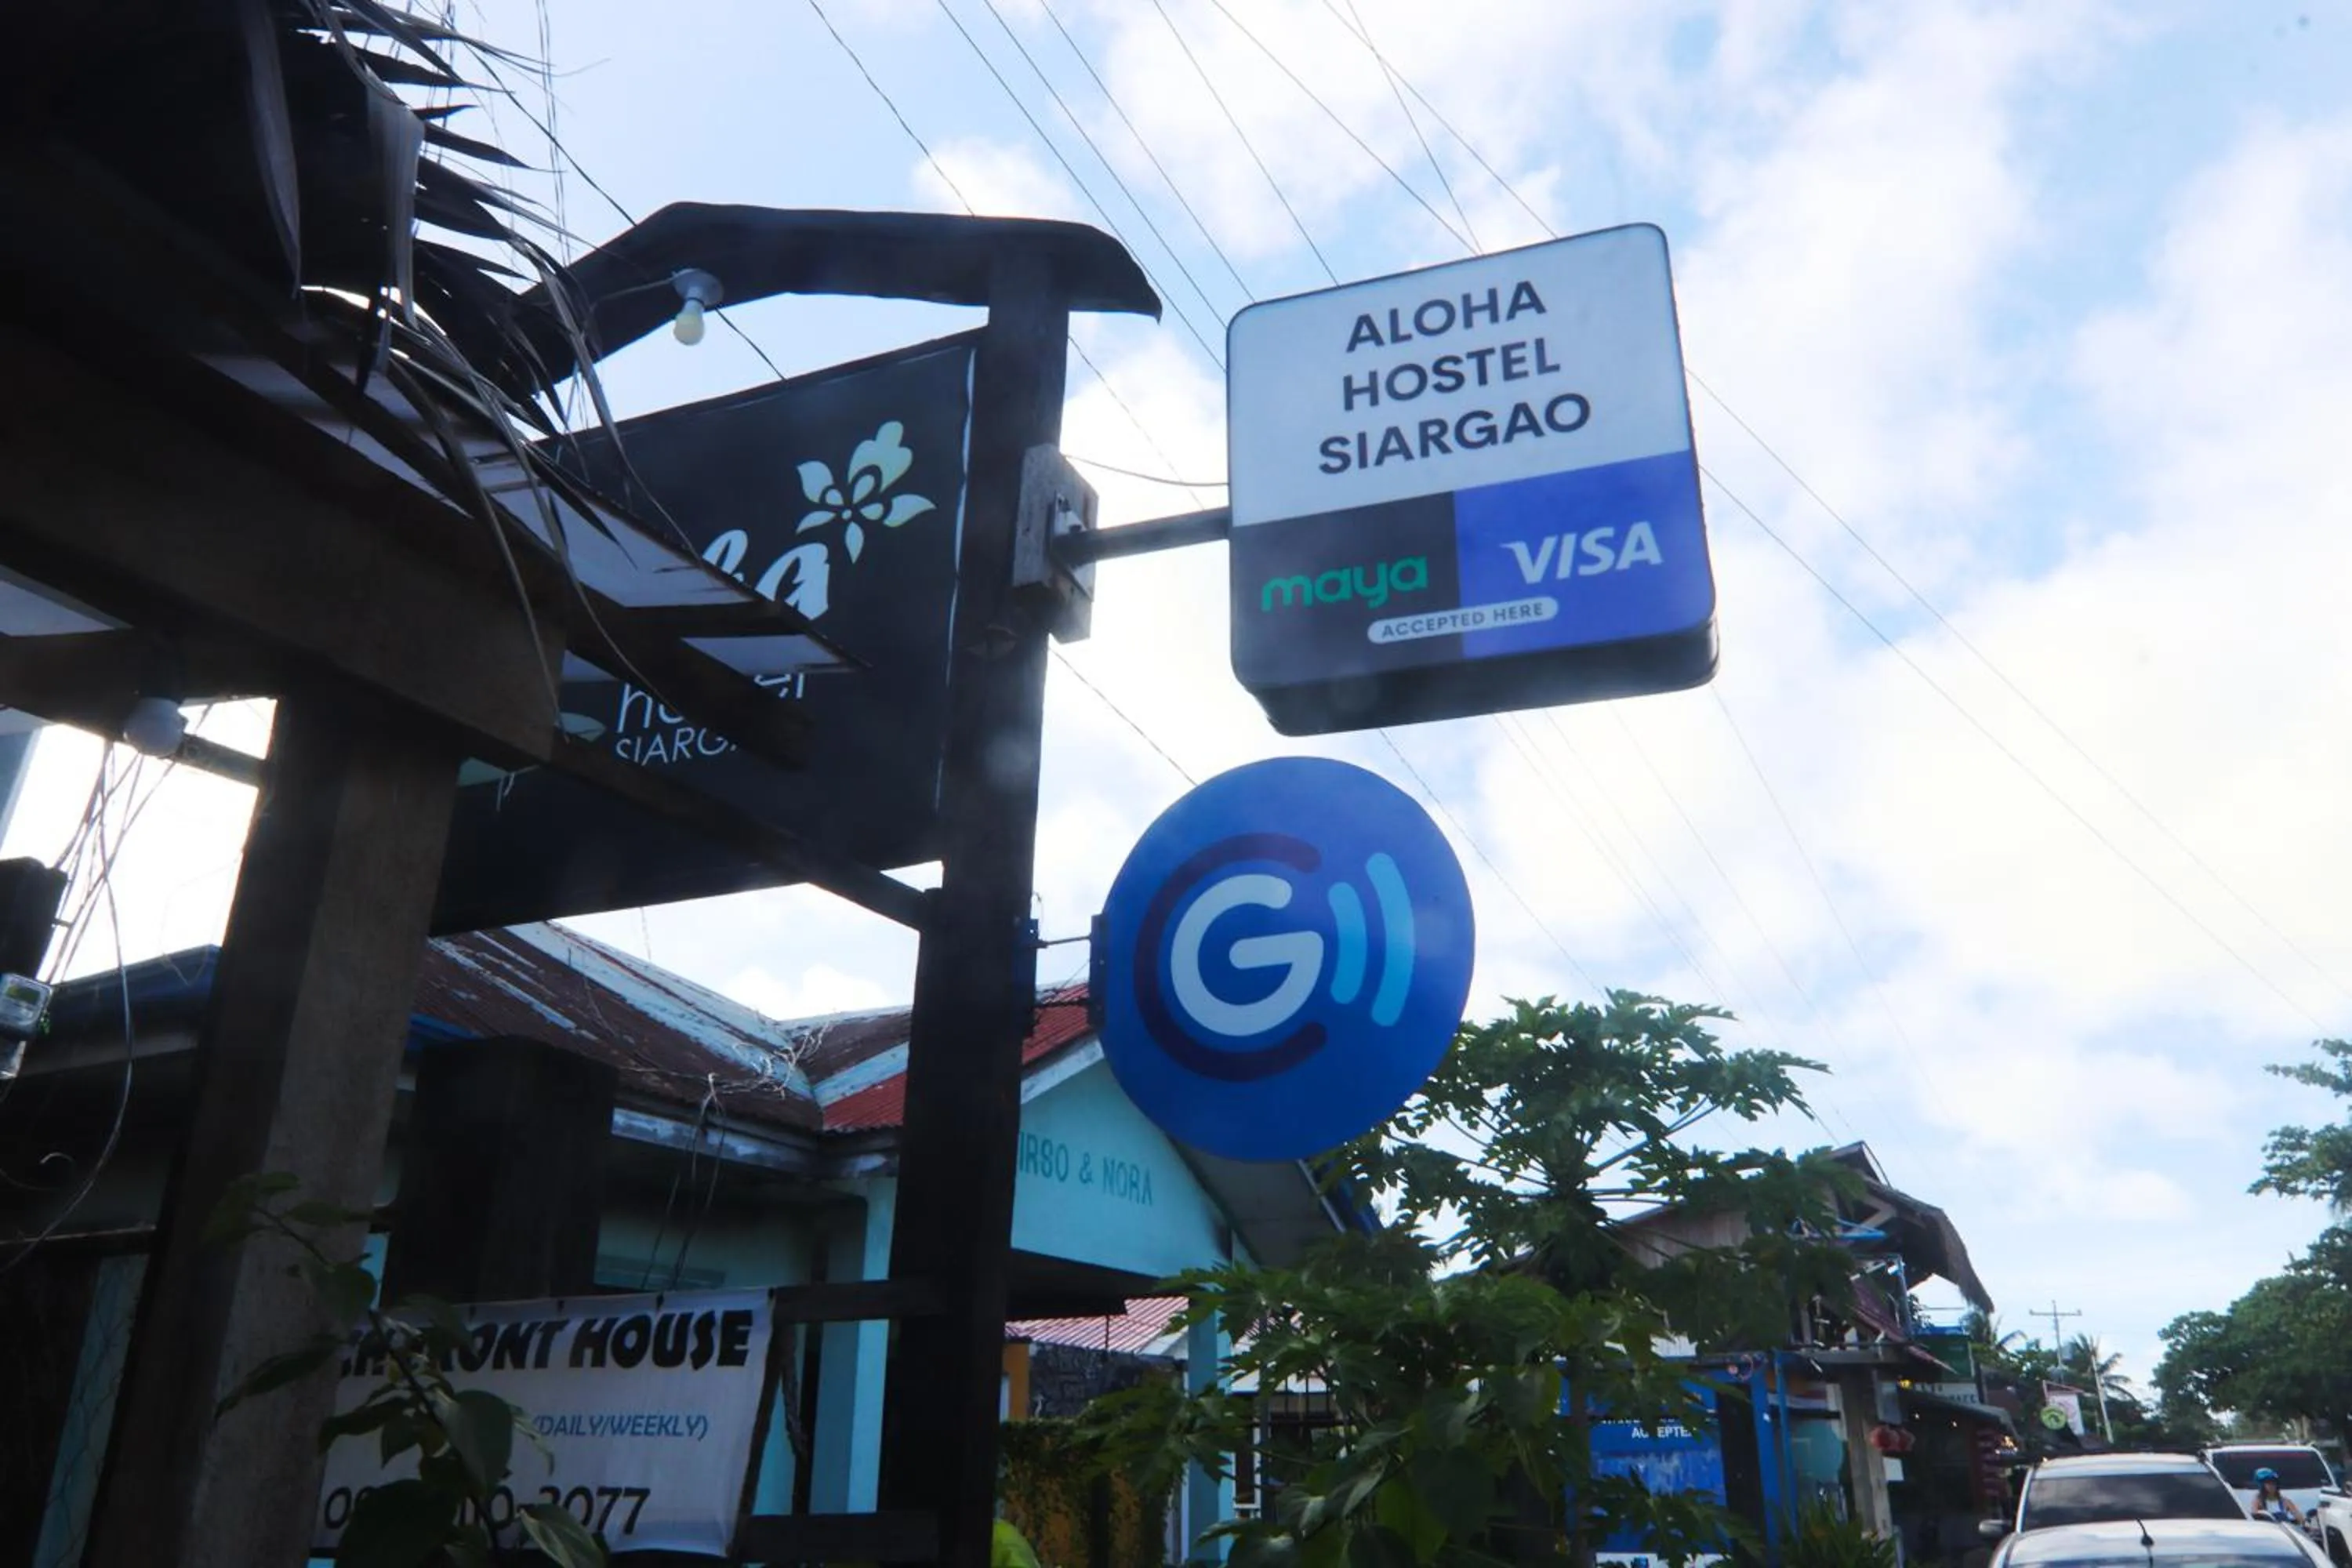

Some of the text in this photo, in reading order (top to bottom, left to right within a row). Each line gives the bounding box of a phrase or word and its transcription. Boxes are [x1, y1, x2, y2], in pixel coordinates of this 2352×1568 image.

[1346, 280, 1548, 353] ALOHA
[1343, 337, 1561, 412] HOSTEL
[1319, 393, 1592, 475] SIARGAO
[1260, 555, 1429, 612] maya
[1500, 521, 1664, 585] VISA
[1381, 602, 1544, 639] ACCEPTED HERE
[1103, 1156, 1152, 1206] NORA
[569, 1309, 753, 1372] HOUSE
